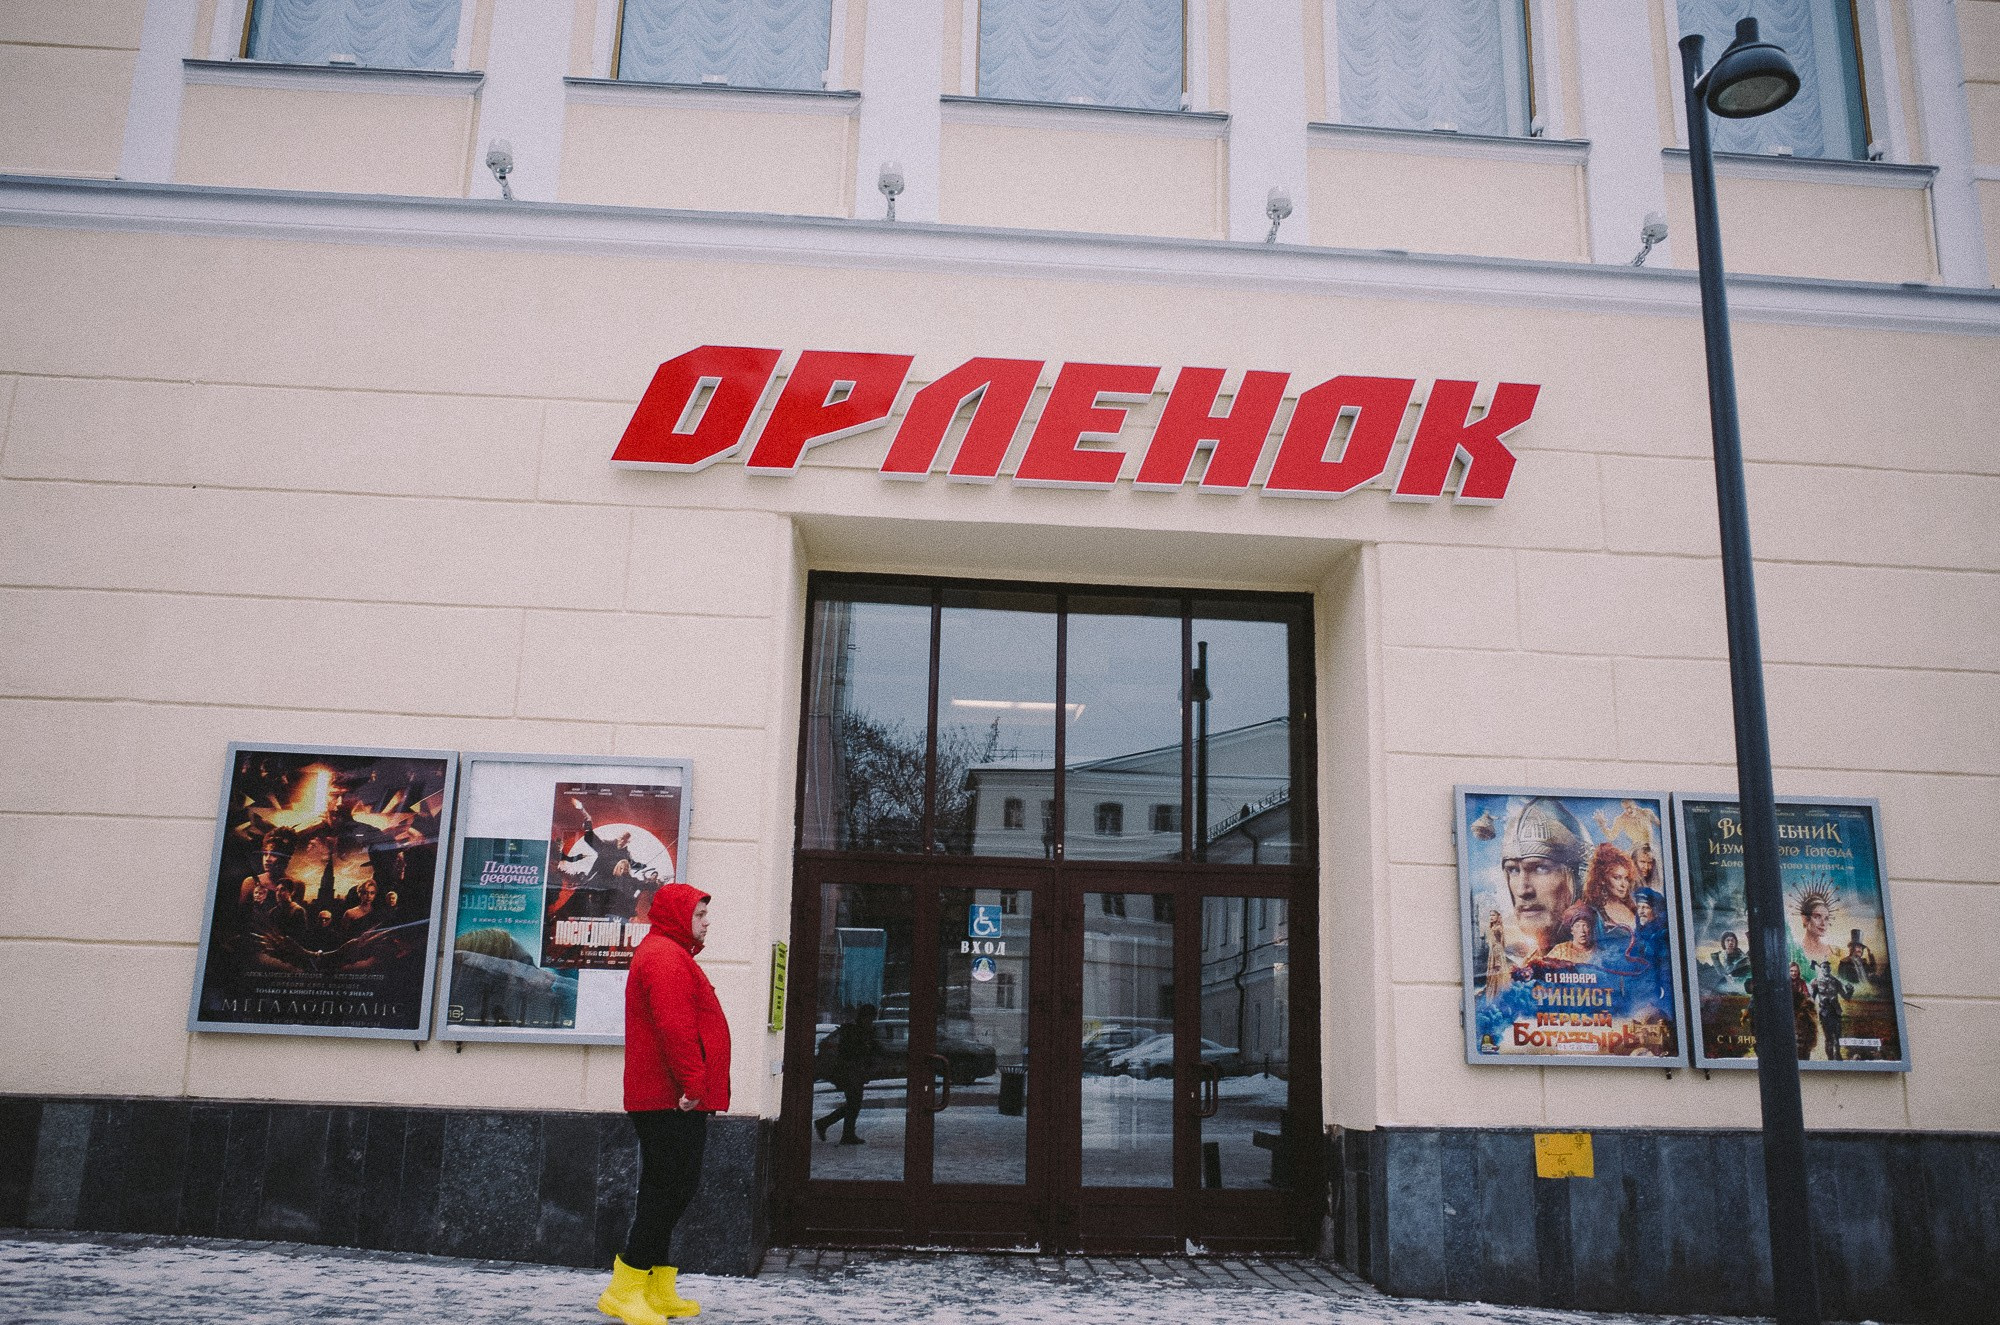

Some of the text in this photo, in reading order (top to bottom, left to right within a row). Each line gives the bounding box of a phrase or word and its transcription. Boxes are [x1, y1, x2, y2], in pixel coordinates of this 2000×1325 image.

[611, 345, 1541, 506] ОРЛЕНОК
[482, 861, 539, 875] Плохая
[480, 873, 539, 886] девочка
[555, 920, 622, 948] ПОСЛЕДНИЙ
[961, 941, 1006, 955] ВХОД
[1545, 973, 1552, 983] С
[1559, 973, 1597, 984] ЯНВАРЯ
[1531, 985, 1614, 1008] ФИНИСТ
[221, 998, 406, 1017] МЕГАЛОПОЛИС
[1536, 1010, 1613, 1028] ПЕРВЫЙ
